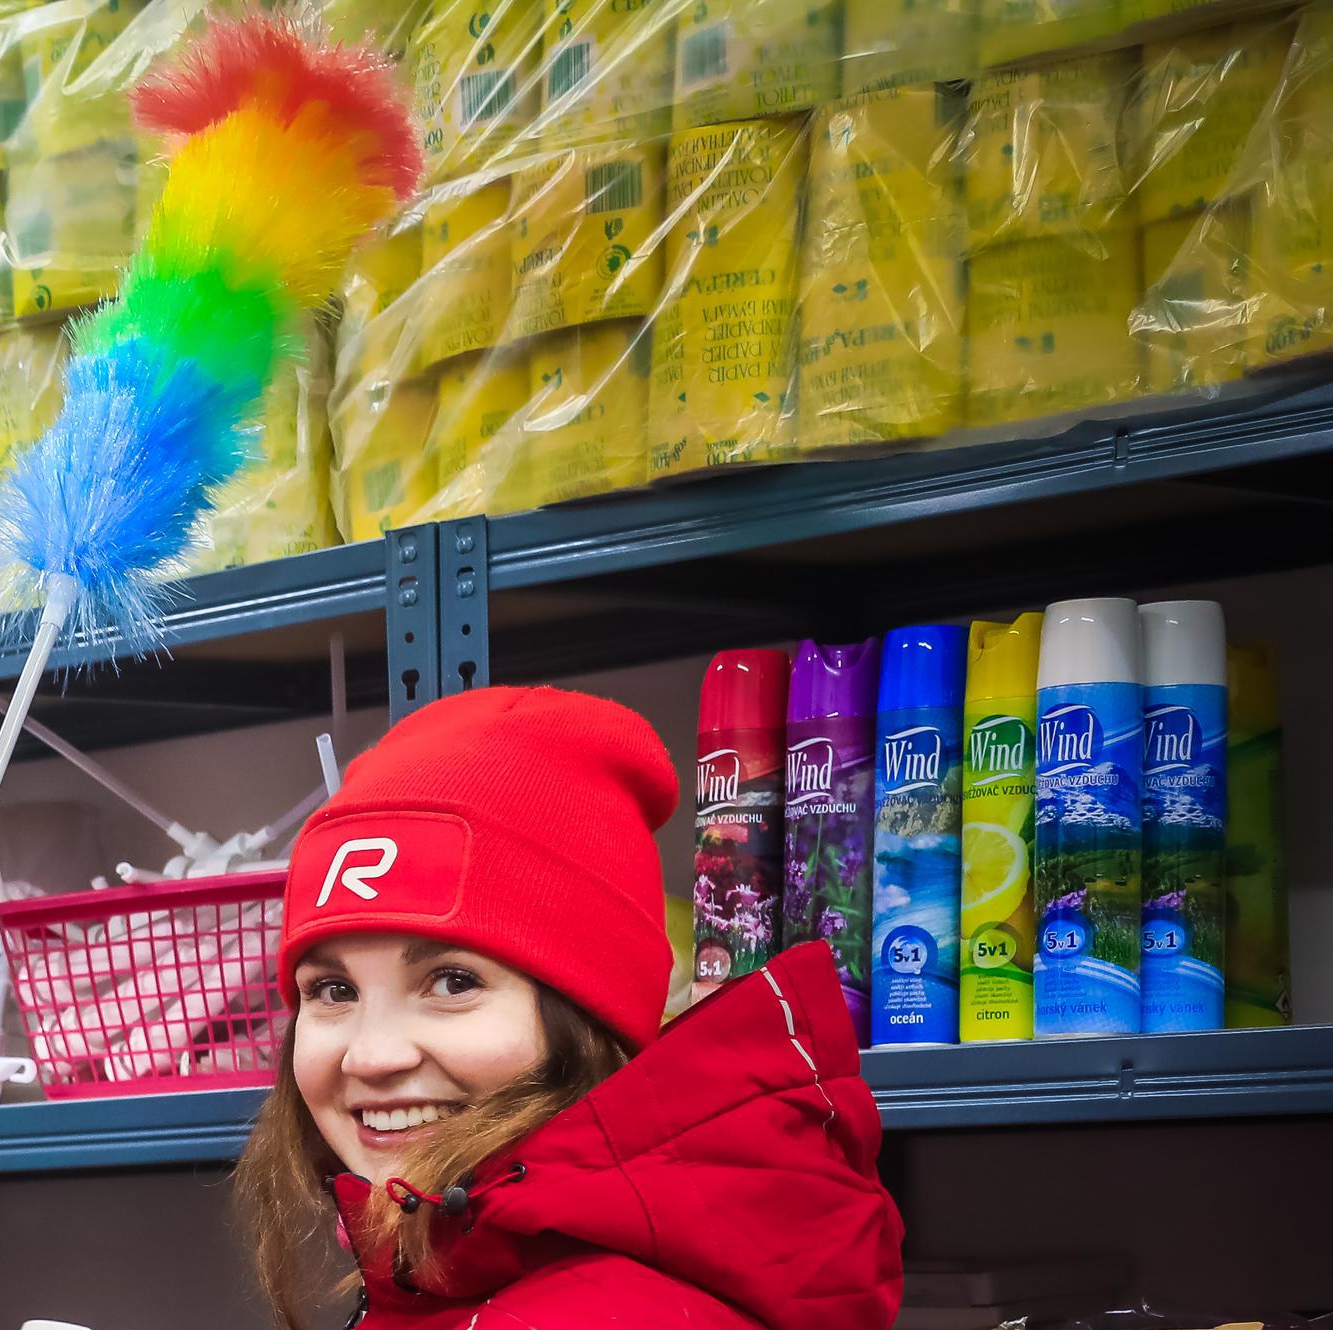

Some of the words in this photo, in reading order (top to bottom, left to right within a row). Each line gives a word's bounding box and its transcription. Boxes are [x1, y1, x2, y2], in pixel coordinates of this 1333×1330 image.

[1040, 713, 1094, 762] Wind
[971, 724, 1026, 772] Wind
[885, 734, 941, 782] Wind
[787, 744, 834, 794] Wind
[697, 757, 740, 804] Wind
[1068, 774, 1119, 786] VZDUCHU
[1003, 785, 1037, 796] VZDUC
[809, 803, 856, 815] VZDUCHU
[717, 813, 763, 825] VZDUCHU
[1070, 1001, 1107, 1013] vánek
[890, 1011, 924, 1025] oceán
[976, 1009, 1010, 1020] citron
